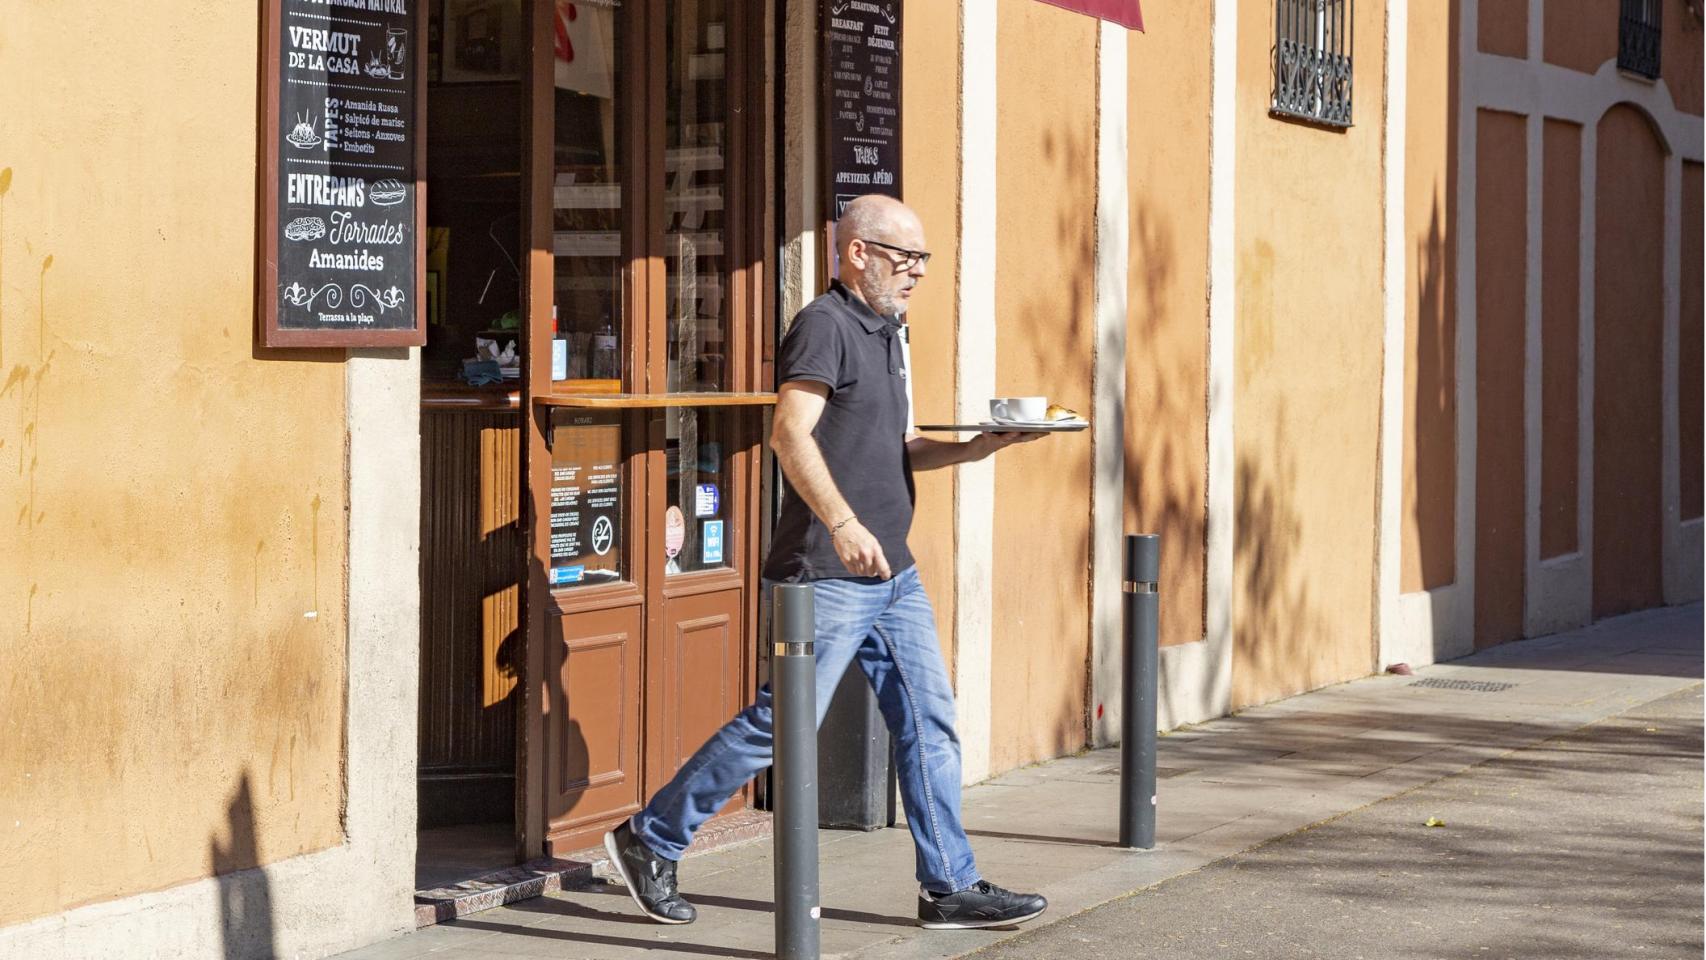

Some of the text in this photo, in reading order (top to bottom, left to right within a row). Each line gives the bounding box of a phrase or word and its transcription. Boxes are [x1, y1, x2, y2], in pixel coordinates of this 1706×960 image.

[368, 0, 407, 15] NATURAL
[832, 18, 864, 31] BREAKFAST
[874, 25, 890, 36] PETIT
[289, 26, 361, 56] VERMUT
[867, 35, 895, 50] DÉJEUNER
[289, 52, 360, 75] DE LA CASA
[345, 100, 399, 113] Amanida Russa
[324, 97, 339, 151] TAPES
[344, 113, 405, 128] Salpicó de marisc
[344, 128, 405, 142] Seitons Anxoves
[344, 141, 375, 153] Embotits
[836, 169, 893, 185] APPETIZERS APÉRO
[288, 173, 365, 207] ENTREPANS
[330, 210, 404, 245] Torrades
[308, 248, 384, 271] Amanides
[318, 312, 345, 322] Terrassa
[350, 312, 357, 322] la
[357, 314, 374, 324] plaça
